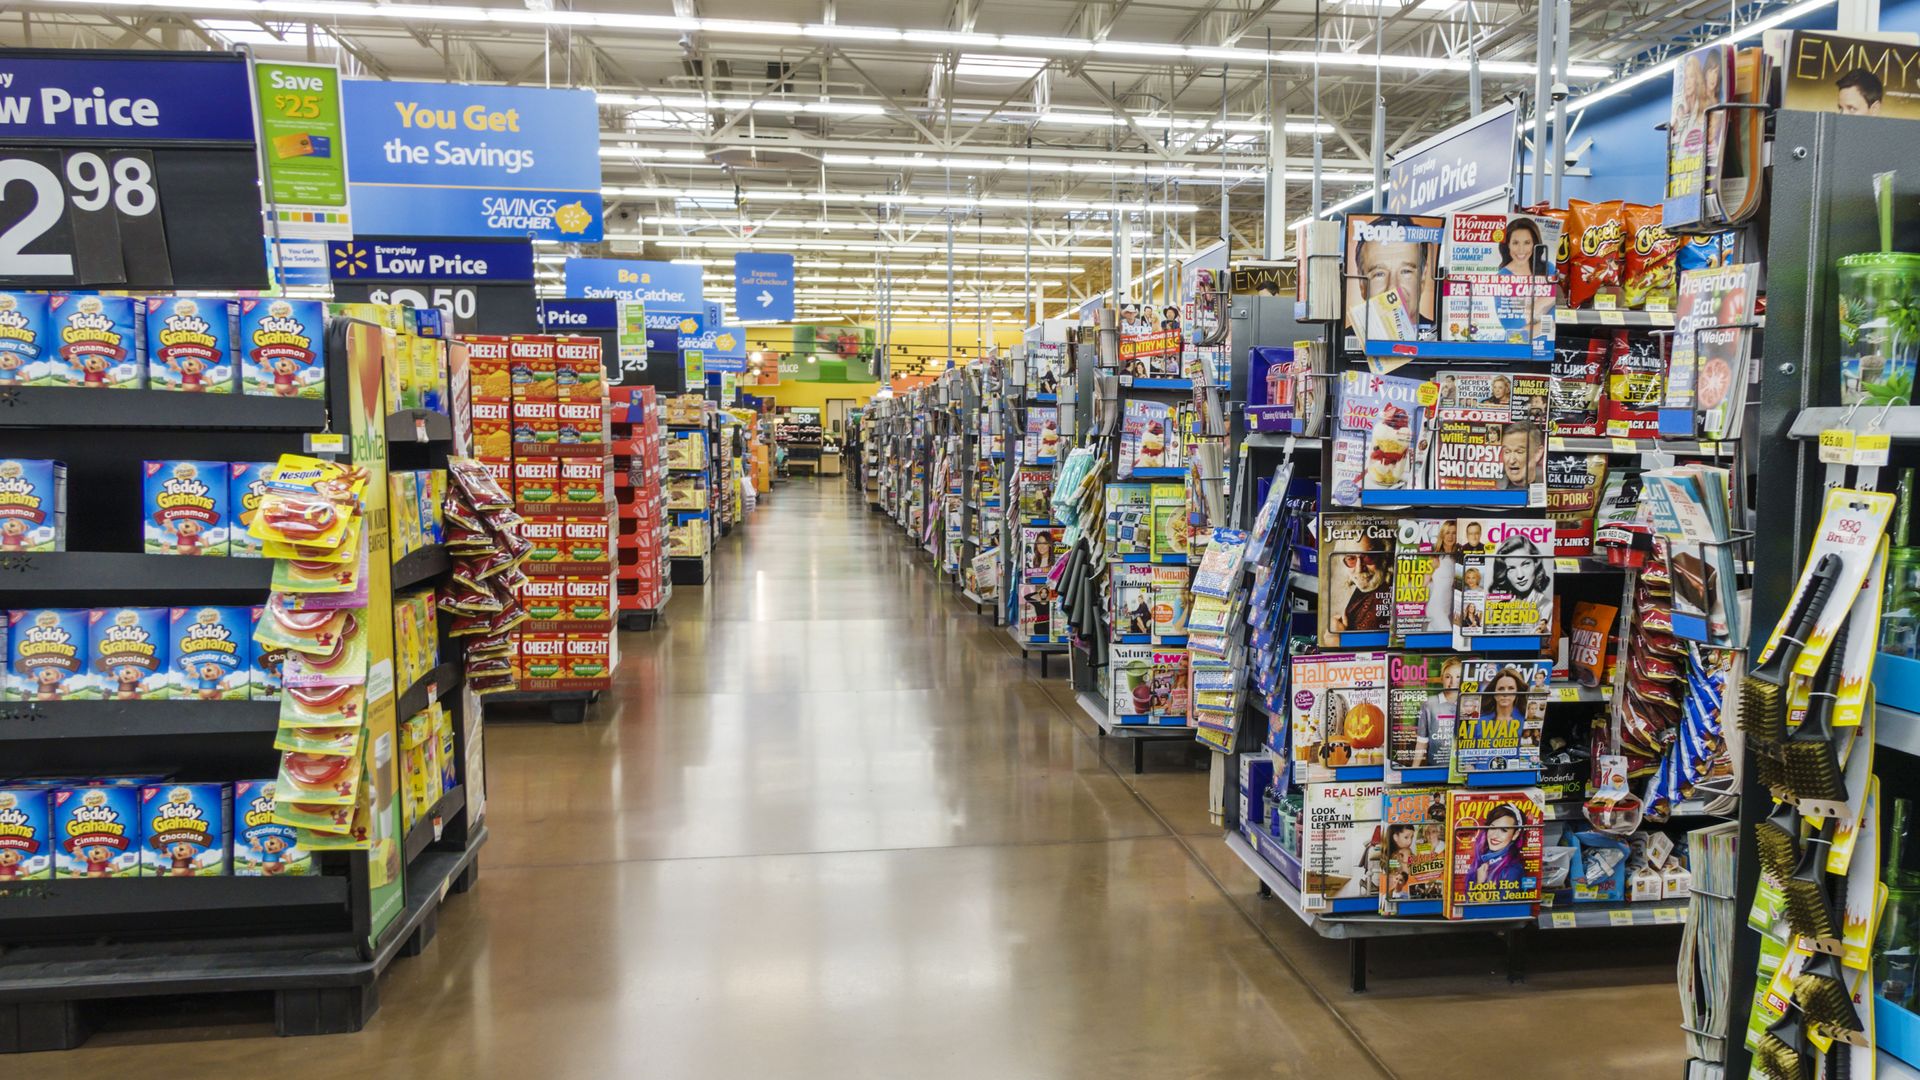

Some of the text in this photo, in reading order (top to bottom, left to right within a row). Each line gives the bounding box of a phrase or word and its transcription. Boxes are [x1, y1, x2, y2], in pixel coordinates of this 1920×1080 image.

[1798, 38, 1920, 89] EMMY
[271, 70, 323, 91] Save
[40, 87, 159, 126] Price
[275, 94, 321, 118] $25
[394, 101, 520, 132] You Get
[383, 138, 535, 173] the Savings
[1412, 157, 1437, 176] Everyday
[1410, 157, 1478, 210] Low Price
[481, 197, 557, 217] SAVINGS
[487, 215, 552, 230] CATCHER
[1455, 215, 1506, 230] Woman's
[1352, 219, 1440, 246] People TRIBUTE
[1454, 229, 1492, 242] World
[374, 245, 417, 256] Everyday
[1481, 247, 1492, 255] LBS
[375, 254, 488, 275] Low Price
[617, 269, 650, 284] Be a
[741, 277, 788, 287] Self Checkout
[751, 270, 778, 279] Express
[1679, 270, 1747, 296] Prevention
[583, 286, 686, 302] Savings Catcher.
[1692, 298, 1716, 316] Eat
[67, 311, 115, 333] Teddy
[164, 315, 209, 335] Teddy
[548, 310, 588, 325] Price
[1678, 315, 1718, 333] Clean
[257, 317, 304, 336] Teddy
[61, 326, 121, 346] Grahams
[159, 330, 216, 348] Grahams
[251, 329, 311, 349] Grahams
[1701, 331, 1735, 346] Weight
[69, 345, 117, 356] Cinnamon
[167, 348, 212, 358] Cinnamon
[260, 348, 306, 359] Cinnamon
[511, 343, 554, 358] CHEEZ-IT
[556, 344, 599, 360] CHEEZ-IT
[1347, 371, 1416, 404] all you
[1513, 387, 1549, 396] MURDER?
[1519, 379, 1544, 388] WAS IT
[513, 403, 557, 418] CHEEZ-IT
[558, 403, 601, 419] CHEEZ-IT
[1343, 399, 1379, 417] Save
[1343, 416, 1373, 430] $100s
[1439, 410, 1510, 423] GLOBE
[1439, 443, 1503, 462] AUTOPSY
[278, 470, 323, 481] Nesquik
[515, 463, 558, 478] CHEEZ-IT
[561, 464, 603, 479] CHEEZ-IT
[1439, 460, 1504, 479] SHOCKER!
[161, 479, 209, 497] Teddy
[155, 491, 216, 510] Grahams
[163, 509, 211, 521] Cinnamon
[520, 523, 564, 538] CHEEZ-IT
[565, 523, 608, 538] CHEEZ-IT
[1324, 525, 1364, 543] Jerry
[1487, 522, 1553, 544] closer
[1838, 519, 1862, 534] BBQ
[1411, 560, 1434, 574] LBS
[1397, 573, 1423, 588] IN 10
[522, 582, 565, 596] CHEEZ-IT
[566, 583, 609, 597] CHEEZ-IT
[1396, 587, 1430, 603] DAYS!
[1485, 601, 1520, 609] Farewell
[1485, 609, 1540, 625] LEGEND
[24, 627, 69, 645] Teddy
[106, 627, 150, 644] Teddy
[186, 622, 230, 642] Teddy
[18, 639, 77, 658] Grahams
[99, 639, 155, 657] Grahams
[179, 635, 237, 654] Grahams
[522, 640, 565, 655] CHEEZ-IT
[566, 640, 609, 655] CHEEZ-IT
[24, 655, 72, 668] Chocolate
[105, 654, 151, 667] Chocolate
[1293, 662, 1386, 685] Halloween
[1390, 656, 1428, 683] Good
[1462, 662, 1497, 682] Life
[1459, 719, 1521, 739] AT WAR
[1477, 737, 1519, 748] THE QUEEN
[1324, 788, 1356, 798] REAL
[72, 804, 119, 825] Teddy
[157, 802, 202, 822] Teddy
[1311, 807, 1336, 815] LOOK
[1311, 814, 1341, 823] GREAT
[65, 818, 125, 837] Grahams
[151, 816, 208, 834] Grahams
[1311, 821, 1355, 830] LESS TIME
[73, 836, 120, 847] Cinnamon
[158, 831, 205, 844] Chocolate
[1411, 861, 1444, 874] BUSTERS
[1469, 880, 1520, 891] Look Hot
[1454, 889, 1538, 901] In YOUR Jeans!
